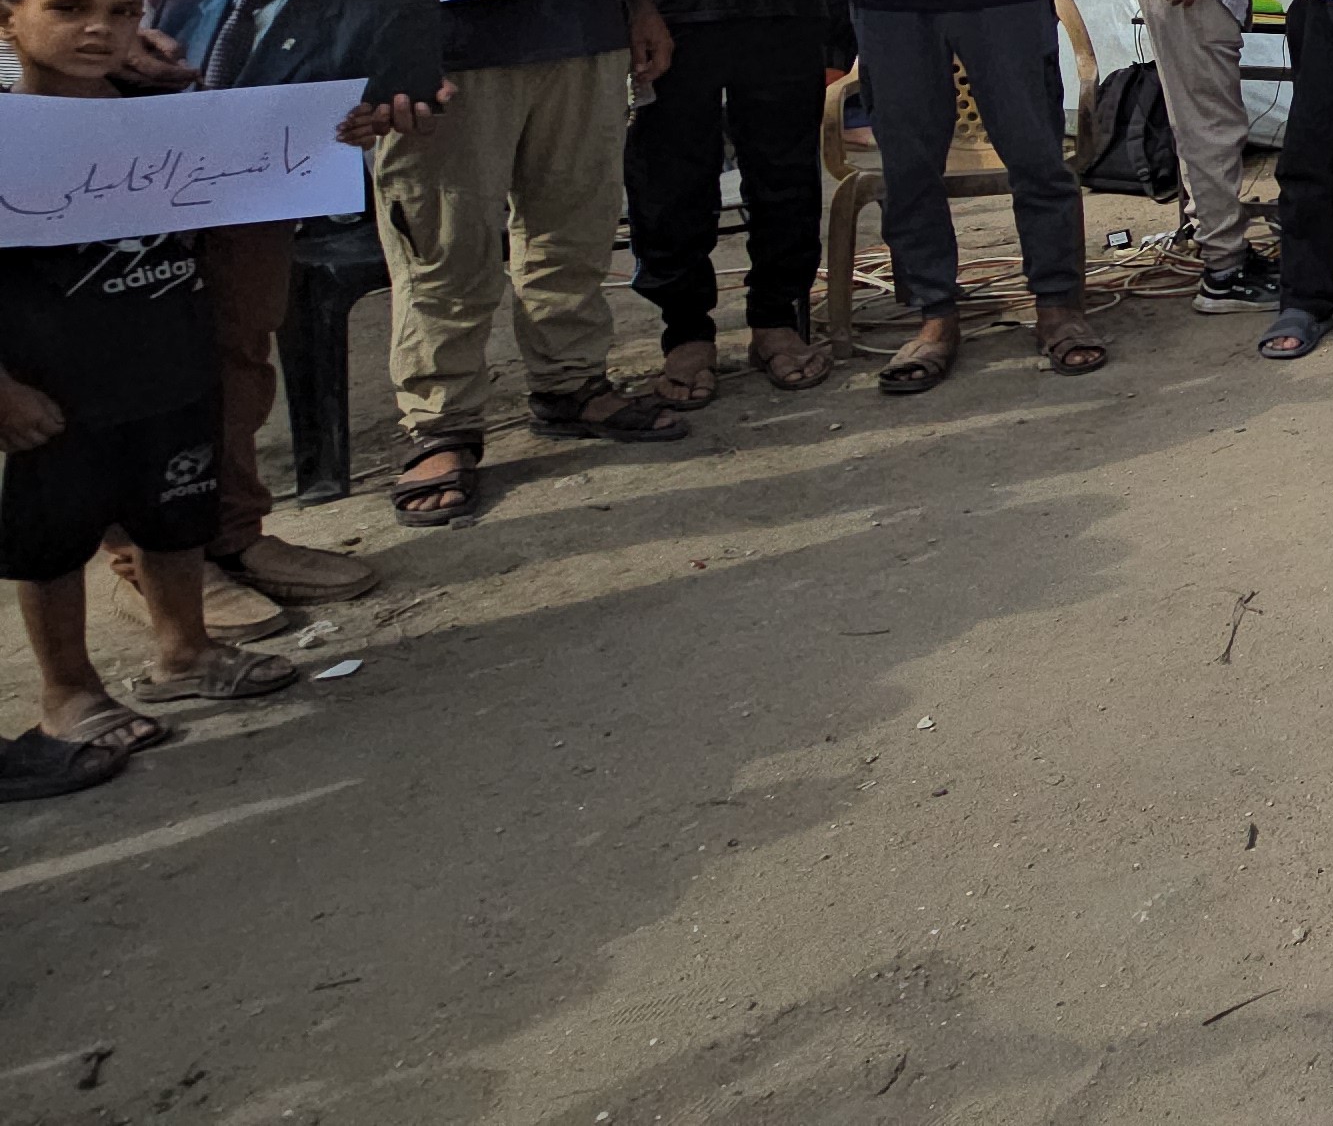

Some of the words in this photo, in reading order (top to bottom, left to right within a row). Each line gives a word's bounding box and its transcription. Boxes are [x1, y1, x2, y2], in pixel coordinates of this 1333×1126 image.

[285, 125, 312, 177] يا
[0, 148, 182, 221] الخليلي
[103, 257, 196, 294] adidas
